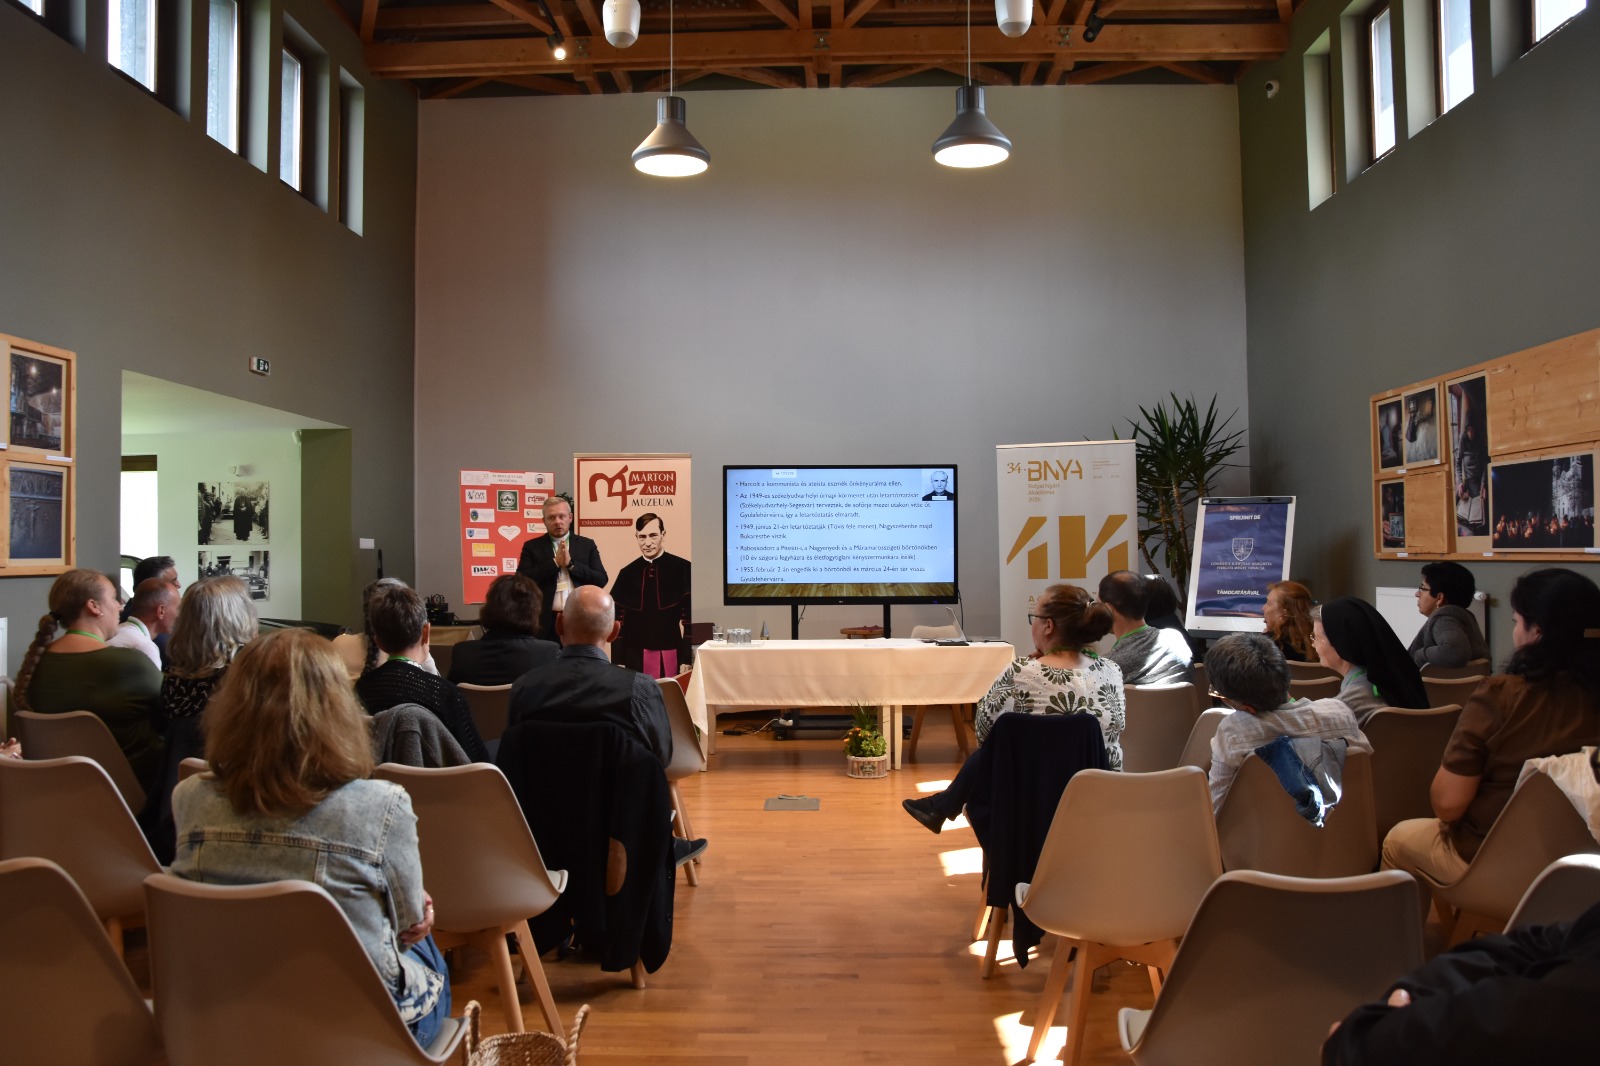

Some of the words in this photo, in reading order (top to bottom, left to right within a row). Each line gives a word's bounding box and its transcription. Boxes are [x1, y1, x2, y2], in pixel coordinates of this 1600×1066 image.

[1028, 459, 1083, 481] BNYA
[631, 472, 674, 482] MÁRTON
[646, 484, 674, 494] ÁRON
[632, 497, 674, 506] MÚZEUM
